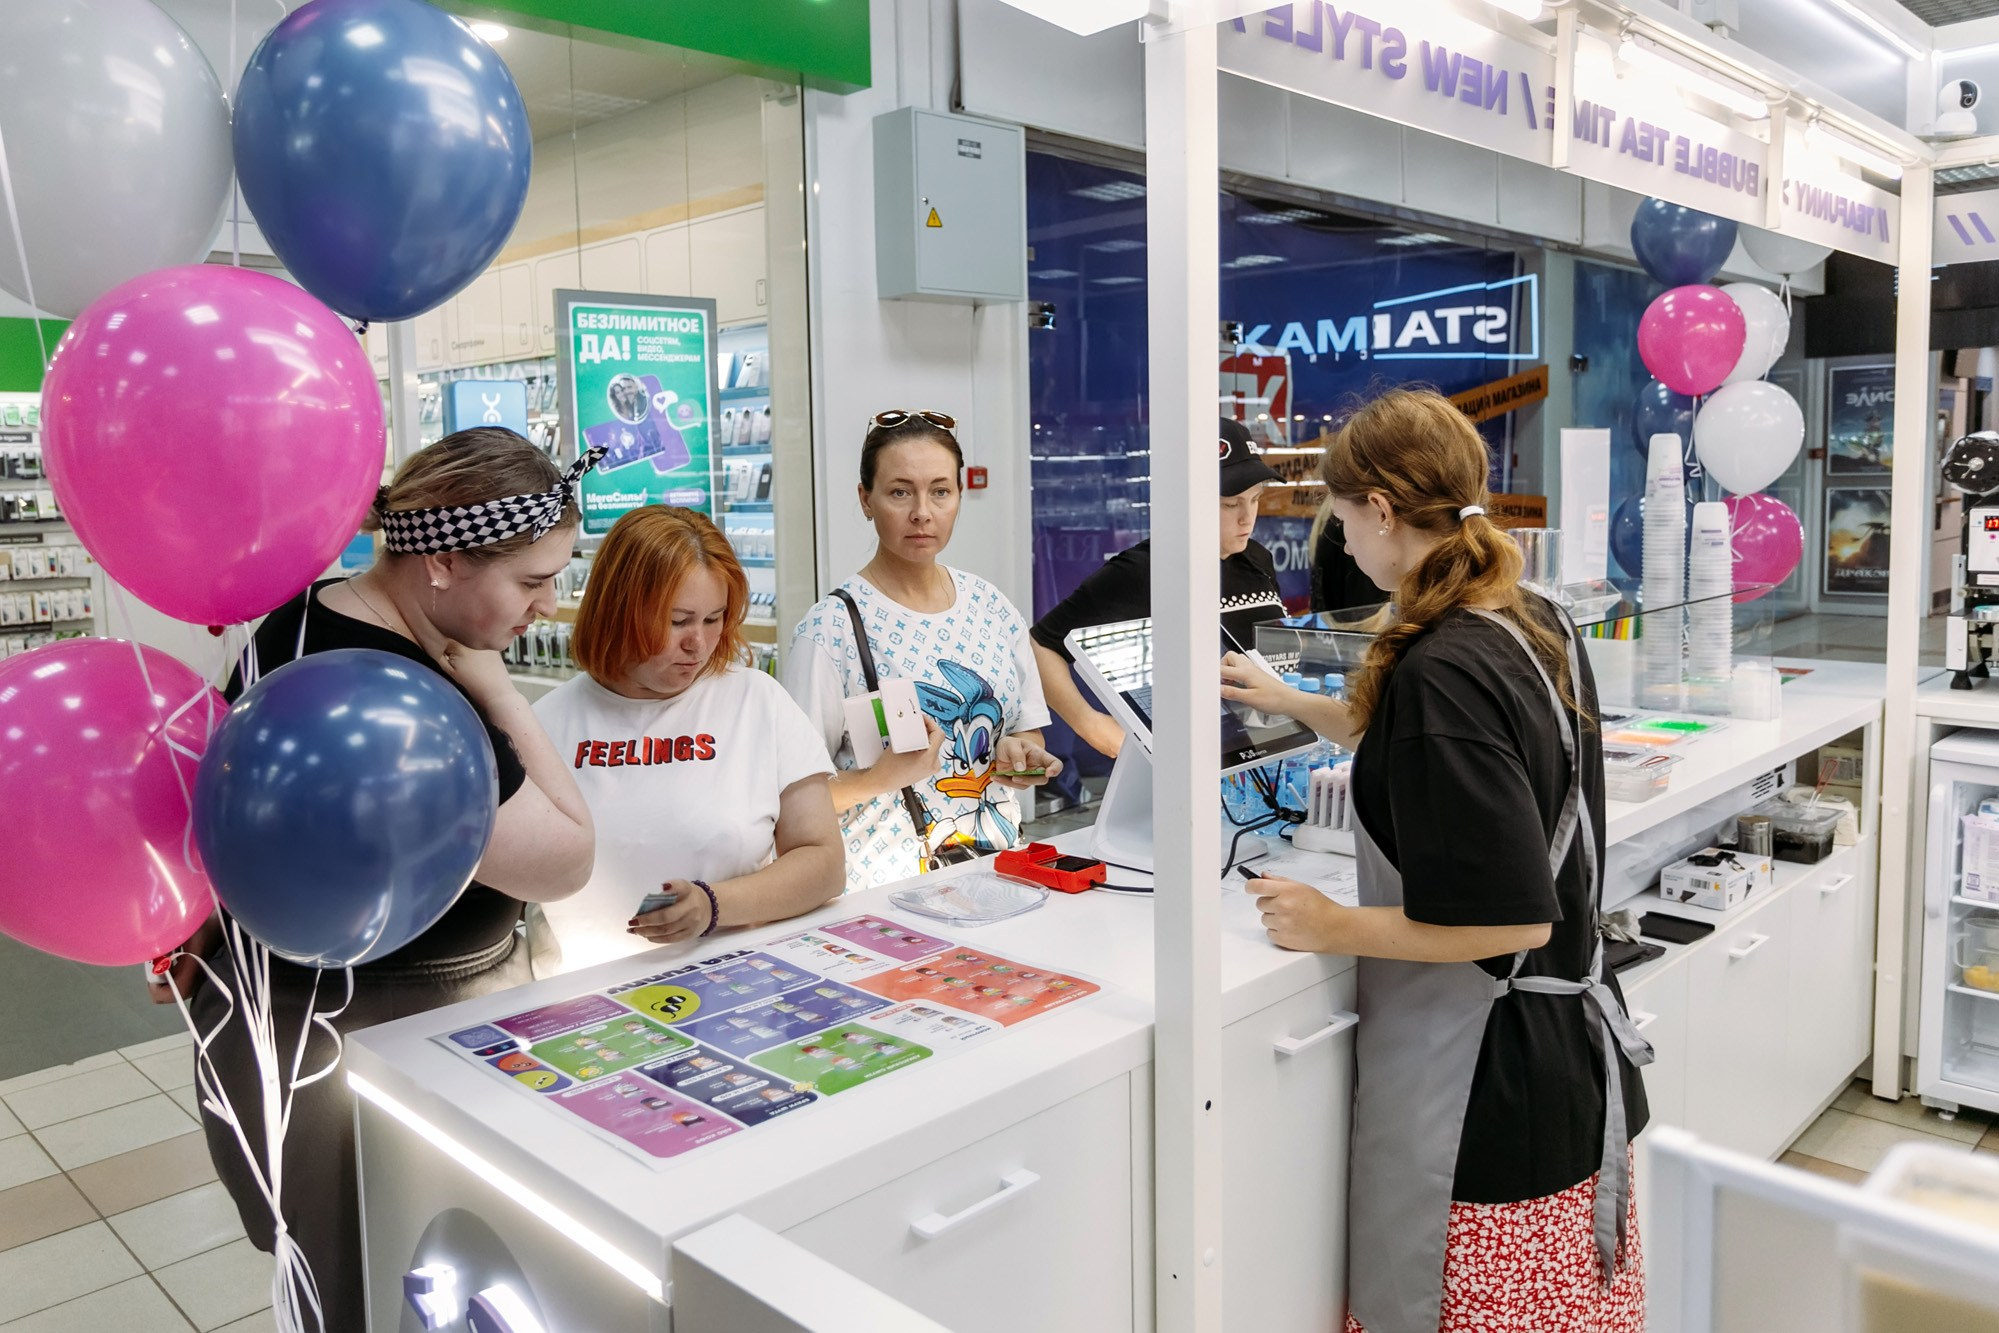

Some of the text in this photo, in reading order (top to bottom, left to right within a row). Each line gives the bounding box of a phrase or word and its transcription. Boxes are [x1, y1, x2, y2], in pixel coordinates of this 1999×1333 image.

[577, 313, 699, 333] БЕЗЛИМИТНОЕ
[579, 334, 631, 364] ДА!
[637, 353, 701, 363] МЕССЕНДЖЕРАМ
[574, 733, 717, 769] FEELINGS
[698, 948, 756, 965] TEA
